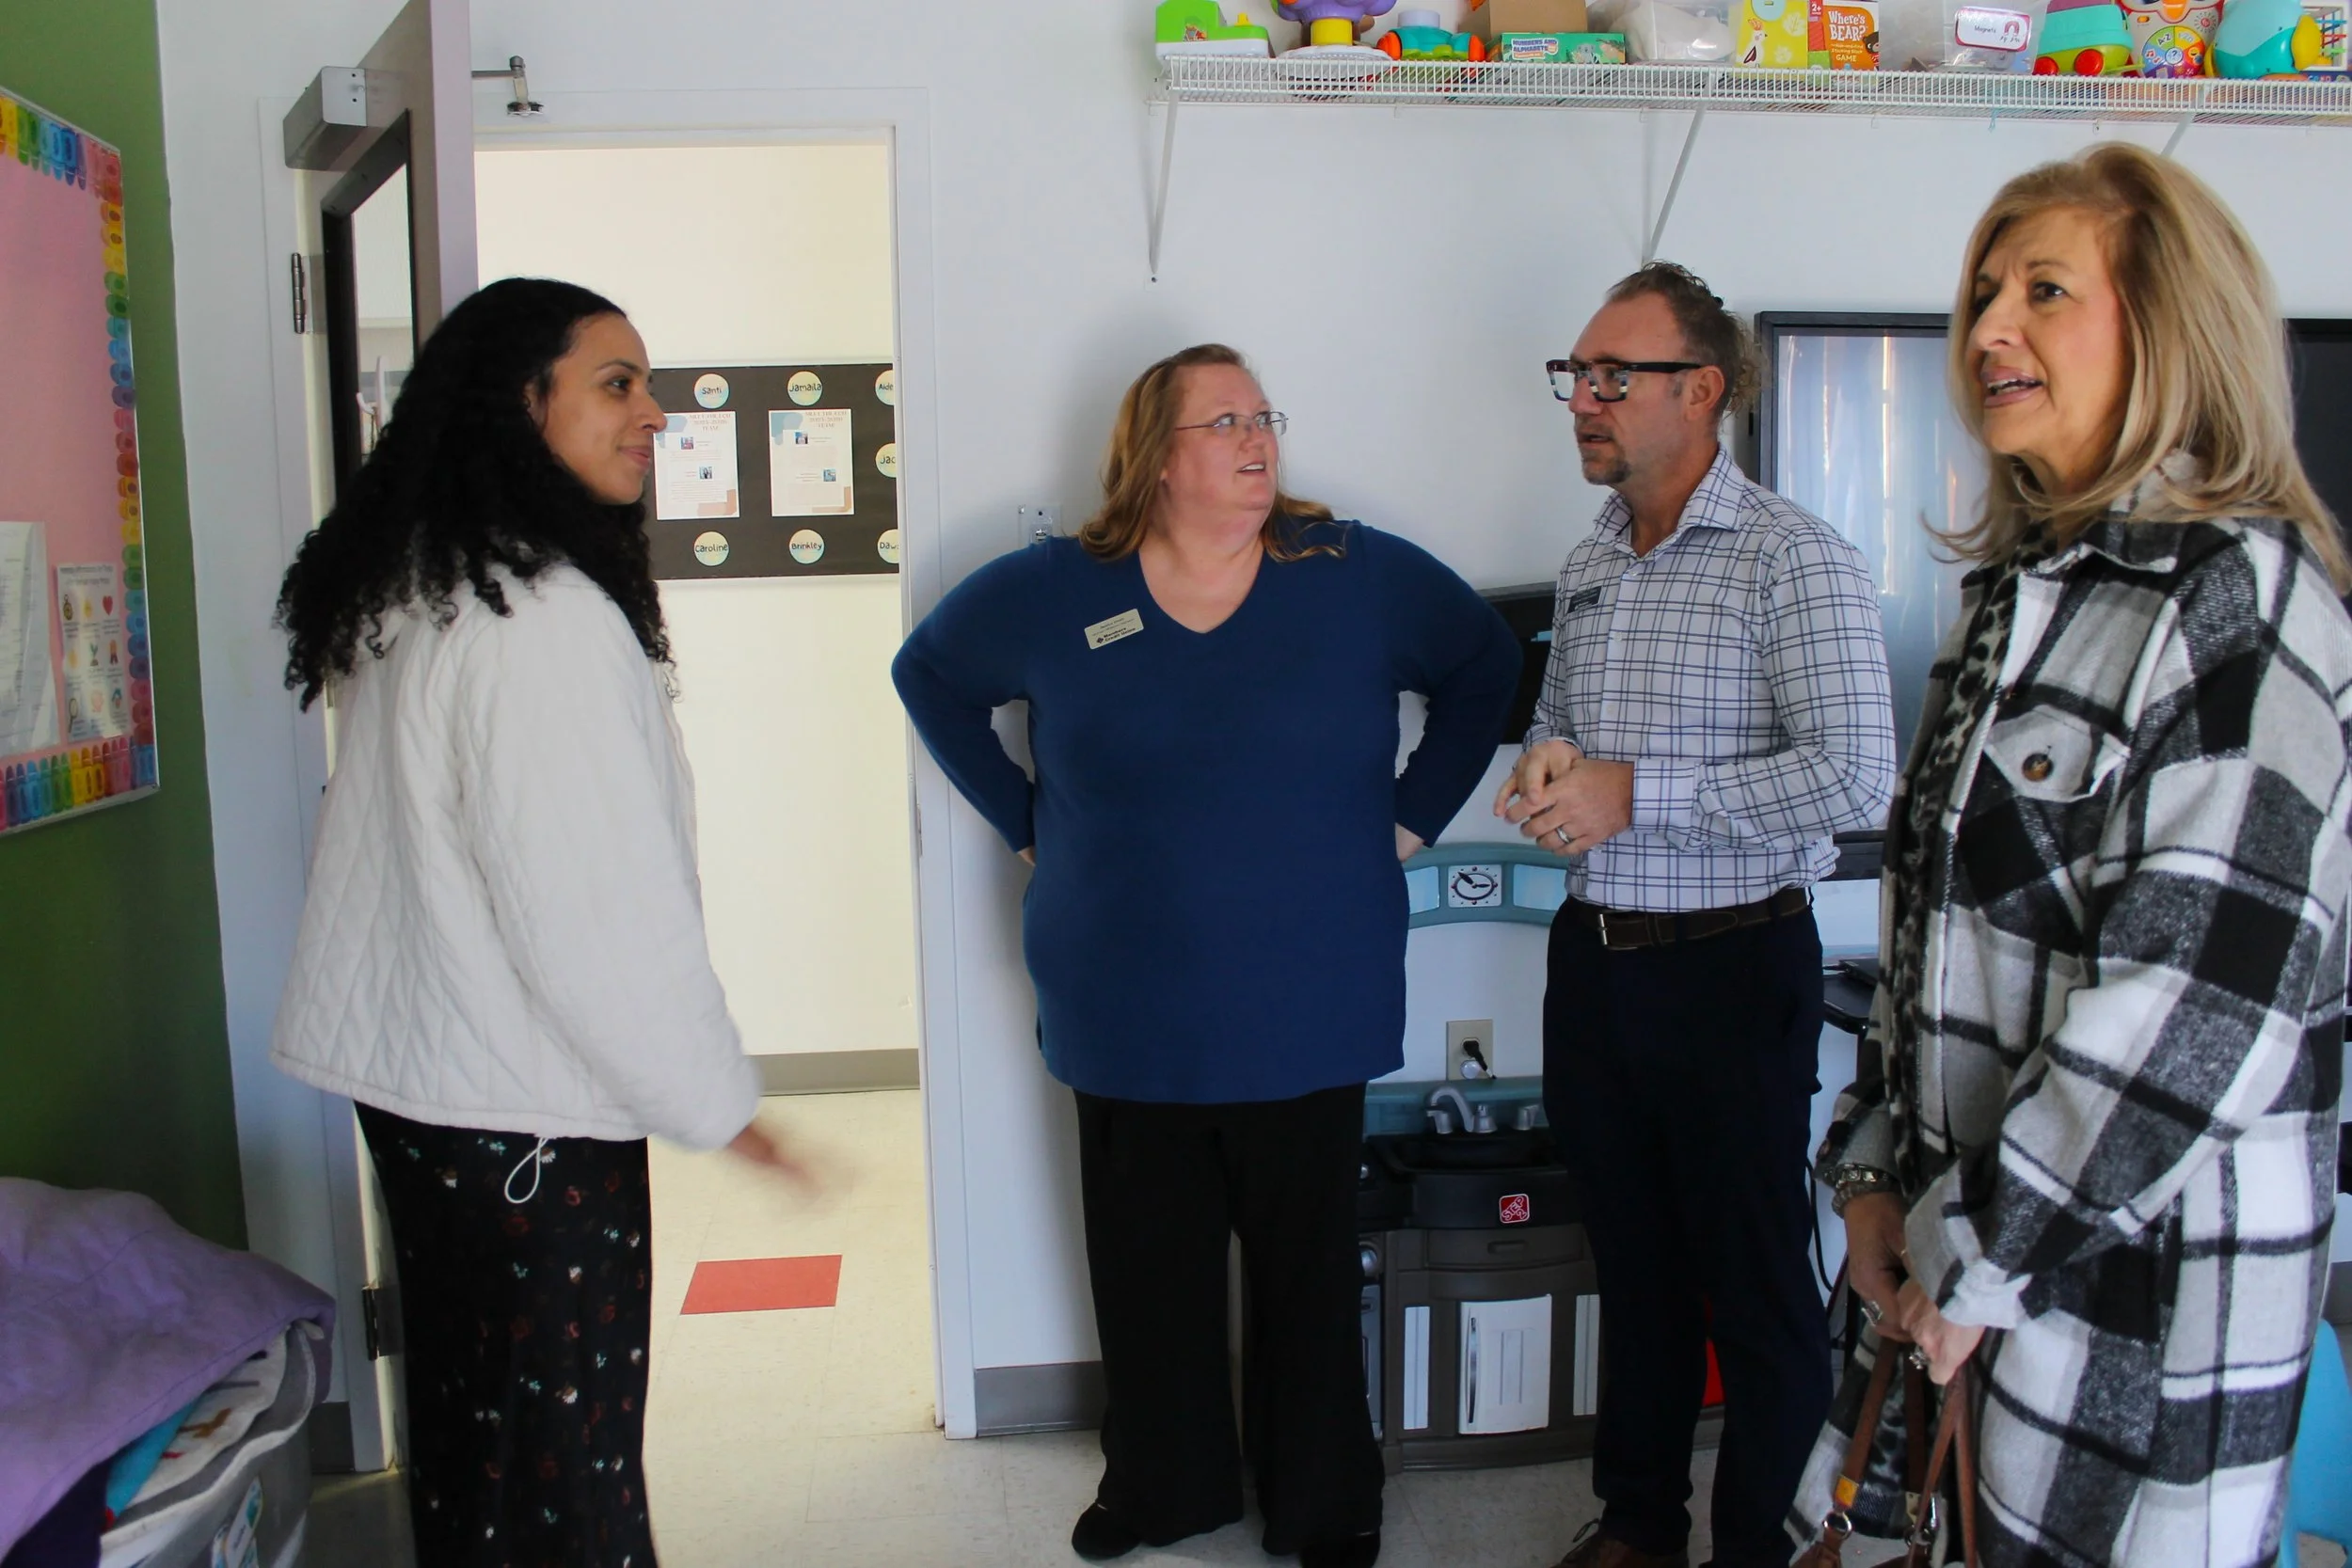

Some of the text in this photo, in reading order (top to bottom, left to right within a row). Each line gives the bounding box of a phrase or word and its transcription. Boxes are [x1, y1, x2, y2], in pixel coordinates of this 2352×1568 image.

[1828, 10, 1866, 24] Where's
[1829, 24, 1867, 41] BEAR?
[702, 387, 722, 395] Santi
[694, 543, 728, 553] Caroline
[791, 542, 823, 551] Brinkley
[1502, 1196, 1524, 1221] STEP
